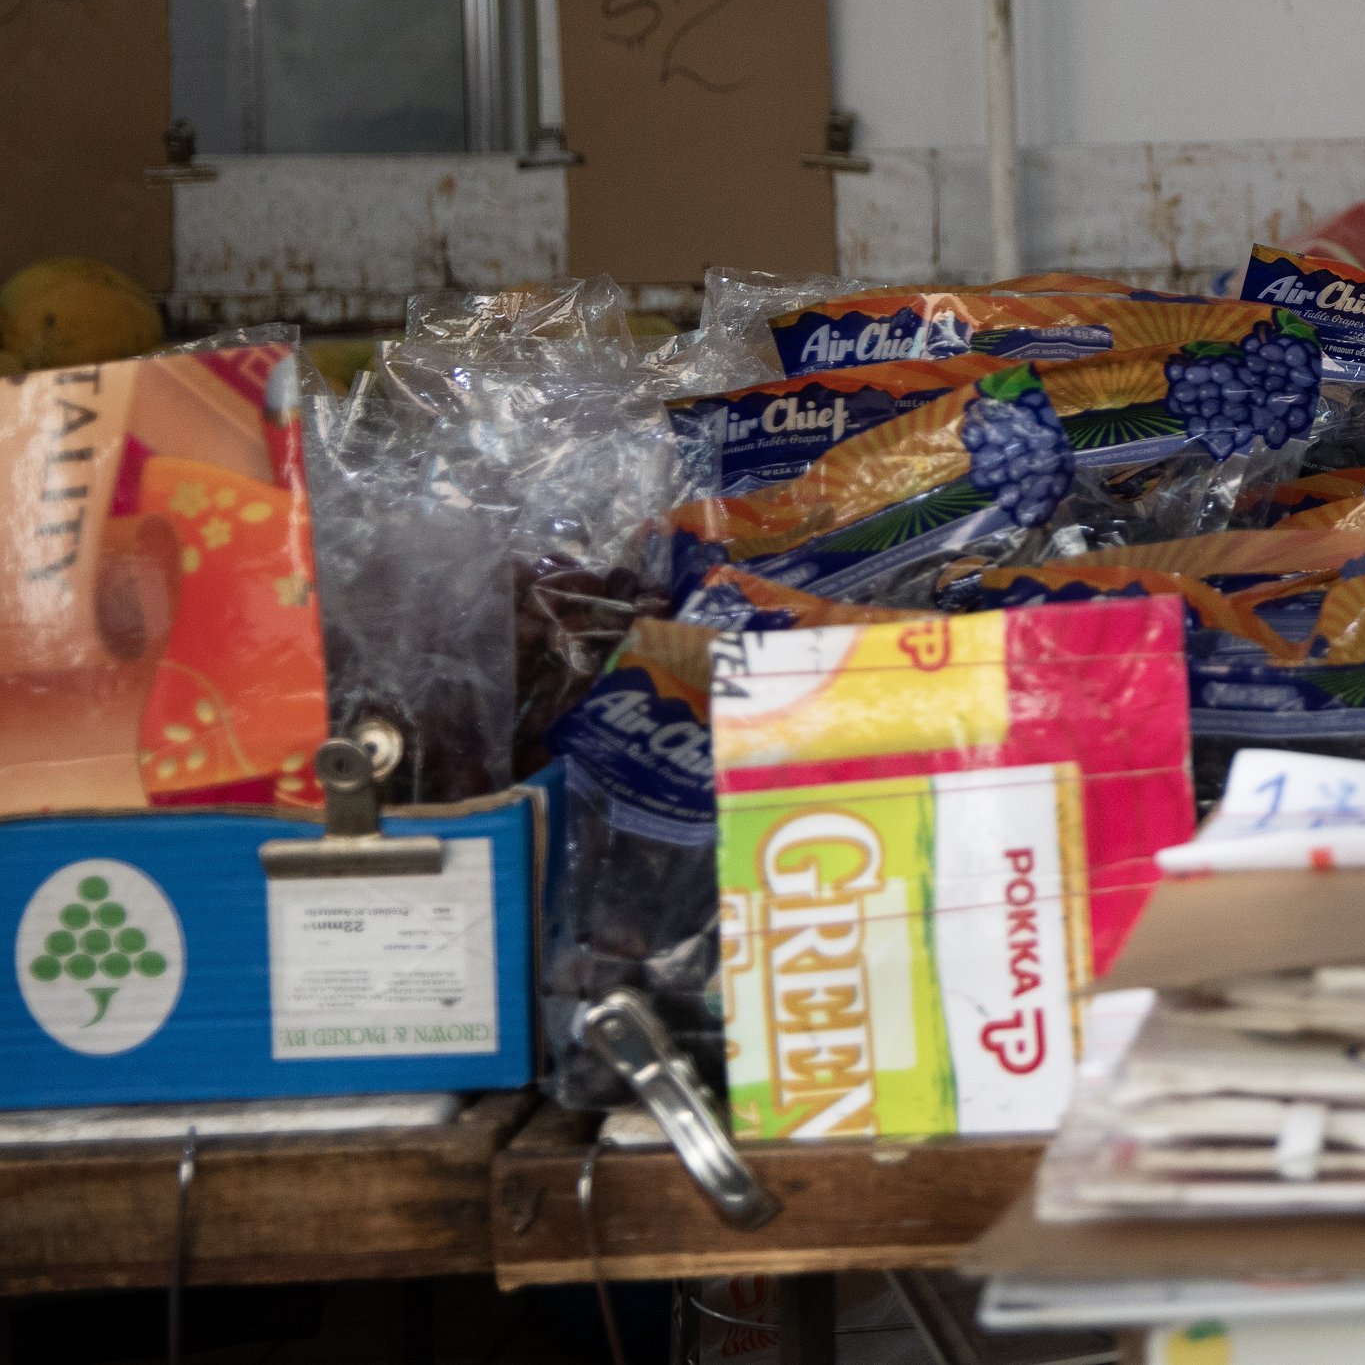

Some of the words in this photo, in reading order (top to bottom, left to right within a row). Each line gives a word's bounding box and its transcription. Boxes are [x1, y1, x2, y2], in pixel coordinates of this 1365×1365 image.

[1257, 276, 1316, 306] Air
[1331, 315, 1365, 329] Grapes
[800, 324, 855, 362] Air
[855, 321, 928, 362] Chief
[1329, 345, 1355, 355] PRODUIT
[761, 396, 850, 441] Chief
[756, 436, 787, 450] Table
[789, 433, 828, 448] Grapes
[585, 688, 650, 757] Air
[1003, 847, 1041, 998] POKKA
[758, 803, 885, 1137] GREEN
[312, 1026, 388, 1046] PACKED
[392, 1026, 408, 1042] &
[412, 1023, 491, 1044] GROWN
